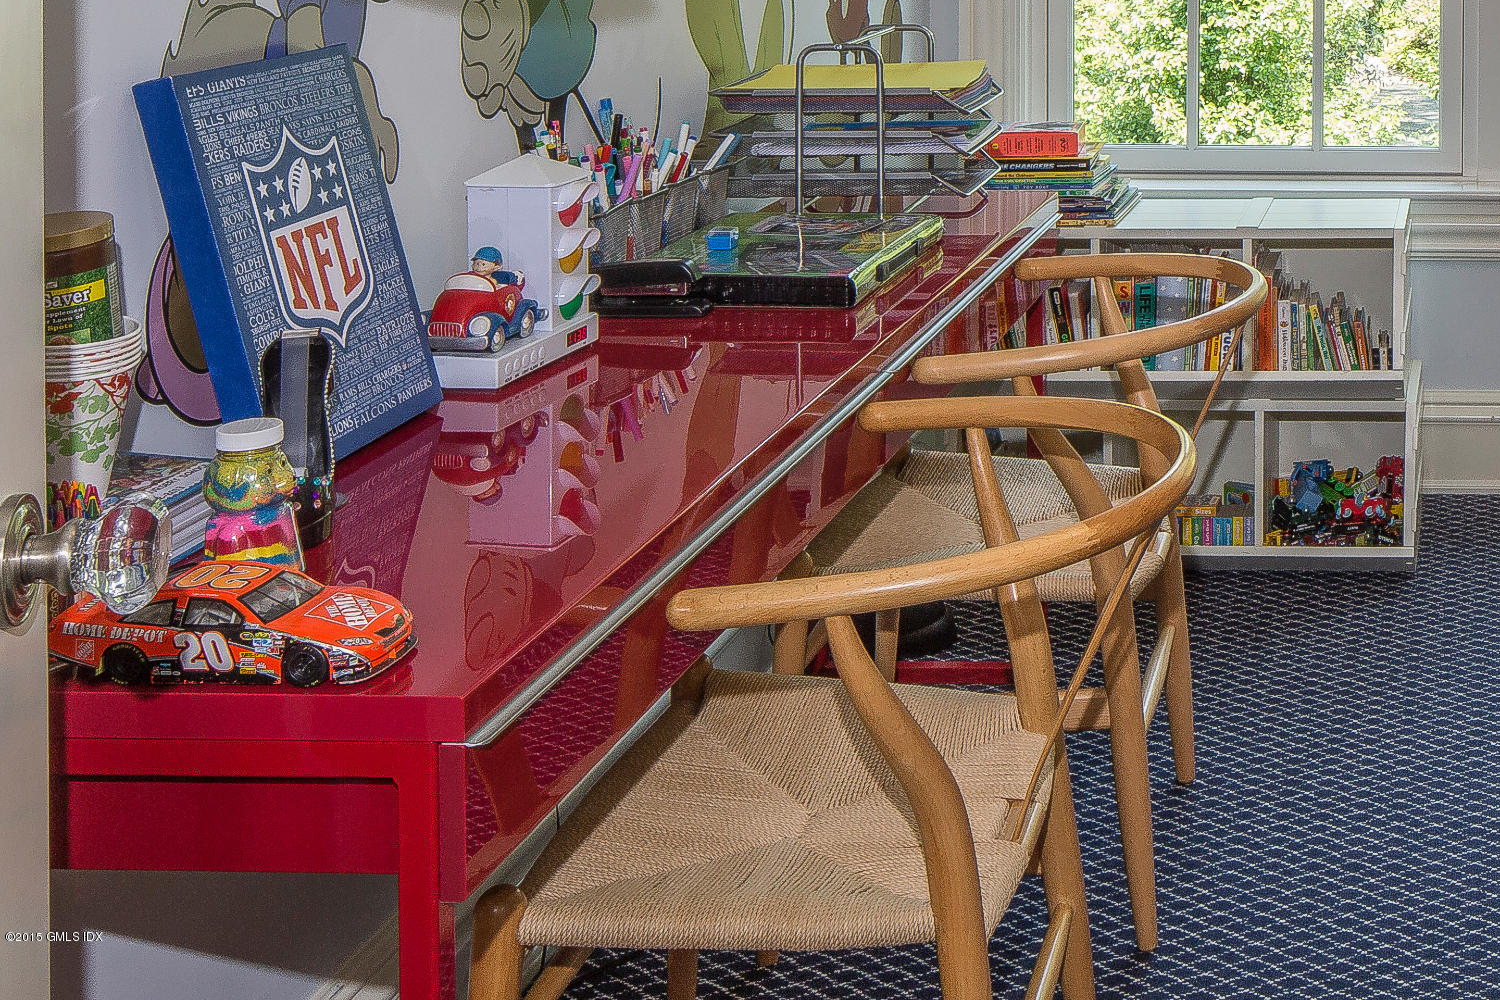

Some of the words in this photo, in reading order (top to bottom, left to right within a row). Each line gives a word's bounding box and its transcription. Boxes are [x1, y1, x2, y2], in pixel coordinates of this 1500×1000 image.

[206, 75, 246, 94] GIANTS
[314, 69, 347, 84] CHARGERS
[225, 105, 259, 123] VIKINGS
[259, 96, 299, 115] BRONCOS
[300, 87, 336, 106] STEELERS
[219, 123, 256, 140] BENGALS
[232, 137, 271, 158] RAIDERS
[275, 216, 363, 312] NFL
[1139, 285, 1151, 312] LIFE
[249, 307, 276, 328] COLTS
[376, 310, 415, 337] PATRIOTS
[371, 373, 405, 396] BRONCOS
[353, 396, 397, 429] FALCONS
[396, 376, 433, 405] PANTHERS
[174, 564, 271, 590] 20
[62, 621, 108, 639] HOME
[109, 626, 168, 643] DEPOT
[173, 630, 236, 672] 20
